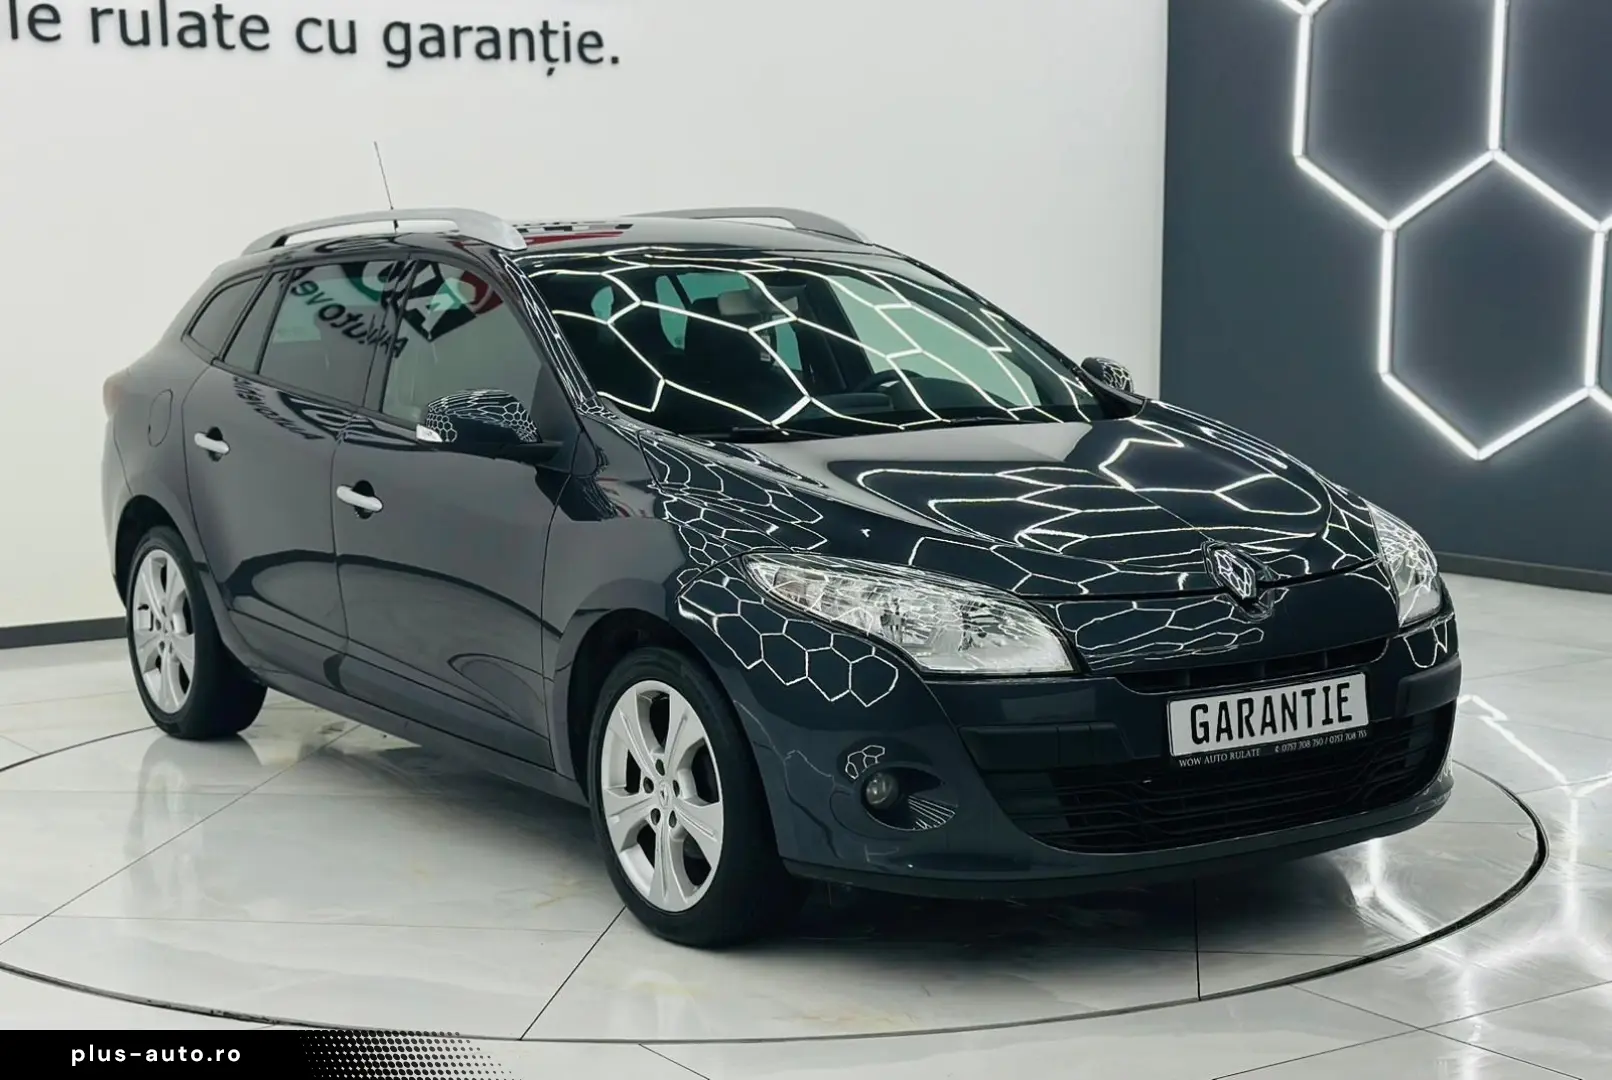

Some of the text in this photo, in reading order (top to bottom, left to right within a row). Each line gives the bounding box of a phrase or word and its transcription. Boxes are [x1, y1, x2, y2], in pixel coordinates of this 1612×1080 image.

[9, 0, 618, 76] le rulate cu garanție.
[1190, 682, 1353, 745] GARANTIE
[1179, 757, 1201, 768] WOW
[1204, 753, 1227, 765] AUTO
[1229, 748, 1260, 760] RULATE
